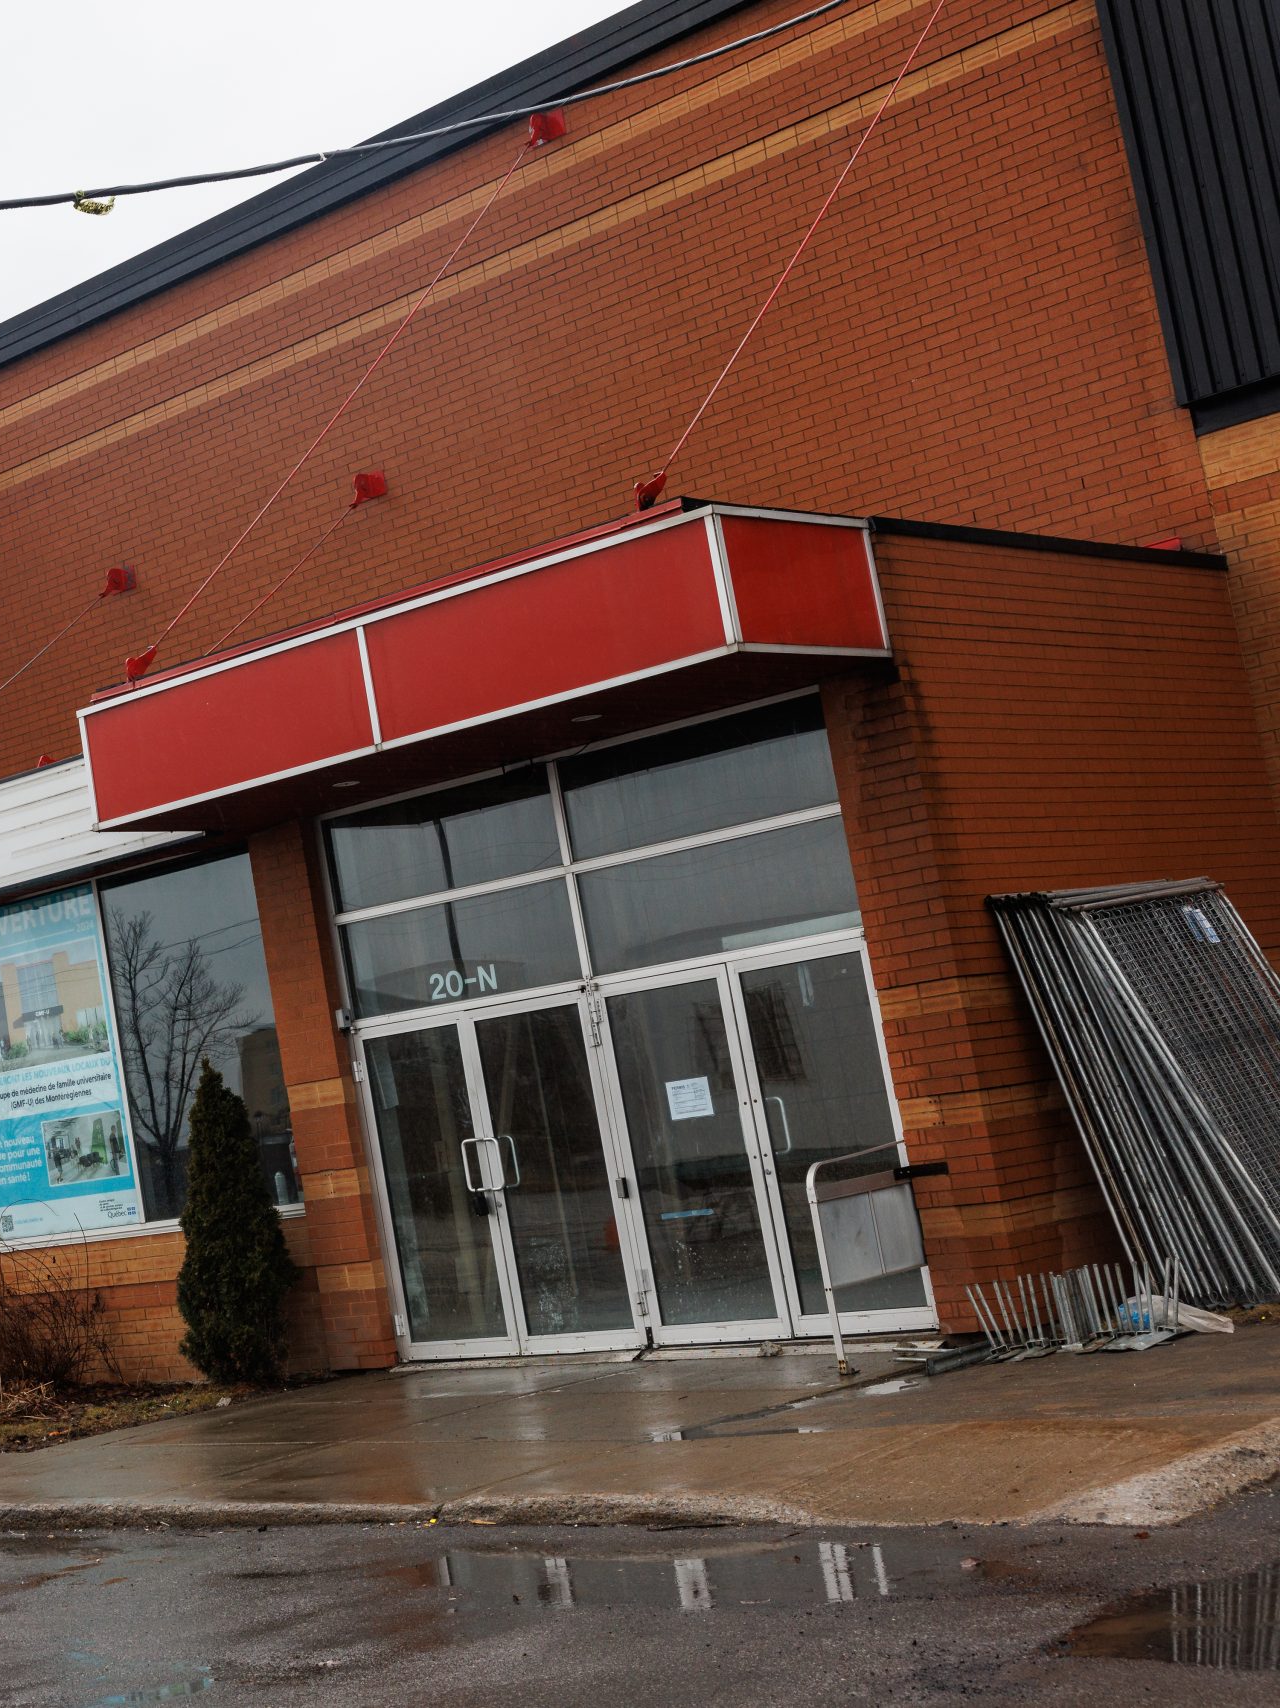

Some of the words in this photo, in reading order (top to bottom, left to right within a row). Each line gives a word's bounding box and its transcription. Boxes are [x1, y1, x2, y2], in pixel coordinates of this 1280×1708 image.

[429, 963, 498, 1001] 20-N
[34, 1064, 71, 1080] NOUVEAUX
[71, 1060, 98, 1073] LOCAUX
[11, 1089, 19, 1097] de
[19, 1084, 47, 1096] médecine
[47, 1082, 56, 1091] de
[56, 1079, 76, 1089] famille
[76, 1072, 112, 1086] universitaire
[11, 1098, 35, 1111] (GMF-U)
[34, 1096, 45, 1105] des
[3, 1135, 35, 1148] nouveau
[7, 1149, 25, 1162] pour
[26, 1147, 40, 1156] une
[107, 1210, 127, 1219] Québec
